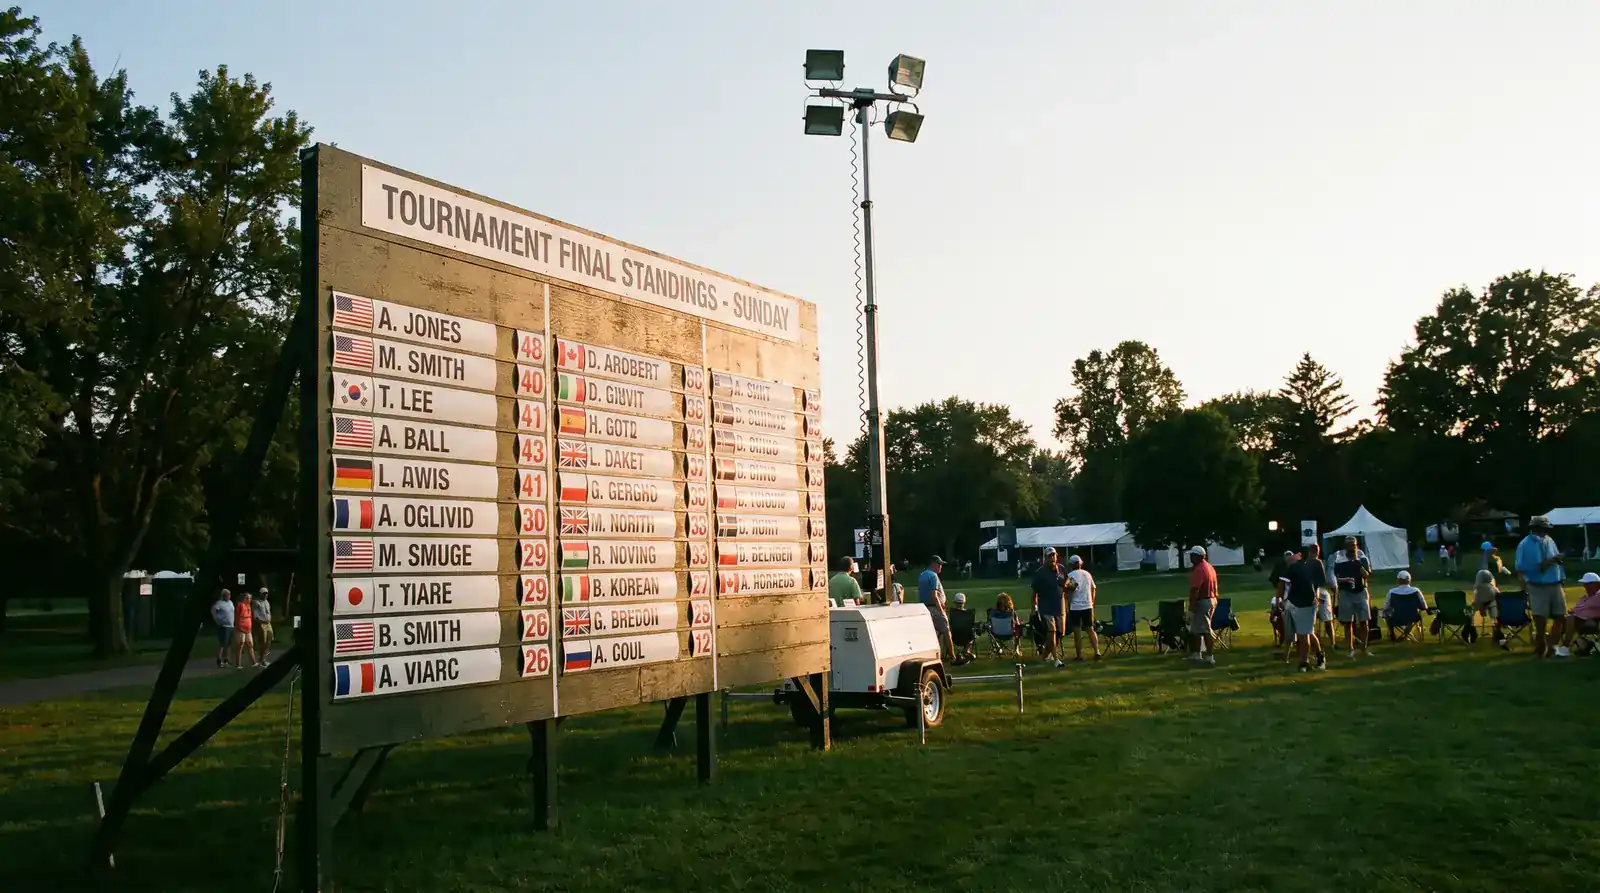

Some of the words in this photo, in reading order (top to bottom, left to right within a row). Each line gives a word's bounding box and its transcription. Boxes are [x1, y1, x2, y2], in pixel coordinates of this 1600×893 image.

[382, 183, 552, 263] TOURNAMENT
[559, 238, 617, 283] FINAL
[621, 257, 718, 311] STANDINGS
[733, 293, 790, 332] SUNDAY
[378, 306, 397, 331] A.
[404, 312, 462, 343] JONES
[521, 335, 543, 360] 48
[379, 345, 401, 370] M.
[408, 350, 465, 381] SMITH
[588, 350, 600, 369] D.
[604, 353, 660, 381] AROBERT
[521, 370, 543, 394] 40
[589, 382, 601, 402] D.
[378, 384, 394, 409] T.
[401, 387, 433, 413] LEE
[521, 403, 541, 428] 41
[589, 414, 602, 434] H.
[378, 424, 397, 448] A.
[404, 427, 450, 452] BALL
[522, 439, 544, 463] 43
[590, 446, 601, 466] L.
[605, 449, 644, 470] DAKET
[379, 463, 394, 488] L.
[522, 474, 542, 499] 41
[592, 480, 603, 500] G.
[378, 504, 397, 527] A.
[404, 504, 474, 529] OGLIVID
[523, 508, 545, 532] 30
[591, 513, 605, 532] M.
[379, 543, 401, 567] M.
[408, 543, 472, 567] SMUGE
[523, 543, 546, 567] 29
[593, 545, 605, 564] R.
[610, 546, 656, 564] NOVING
[524, 578, 547, 603] 29
[593, 579, 605, 597] B.
[611, 576, 659, 597] KOREAN
[693, 574, 708, 595] 27
[741, 574, 750, 590] A.
[379, 584, 394, 607] T.
[400, 582, 453, 606] YIARE
[525, 613, 548, 638] 26
[594, 611, 606, 631] G.
[611, 607, 659, 629] BREDON
[379, 624, 397, 647] B.
[404, 619, 461, 645] SMITH
[696, 633, 711, 653] 12
[525, 648, 549, 674] 26
[594, 644, 607, 664] A.
[379, 664, 398, 689] A.
[404, 658, 459, 685] VIARC
